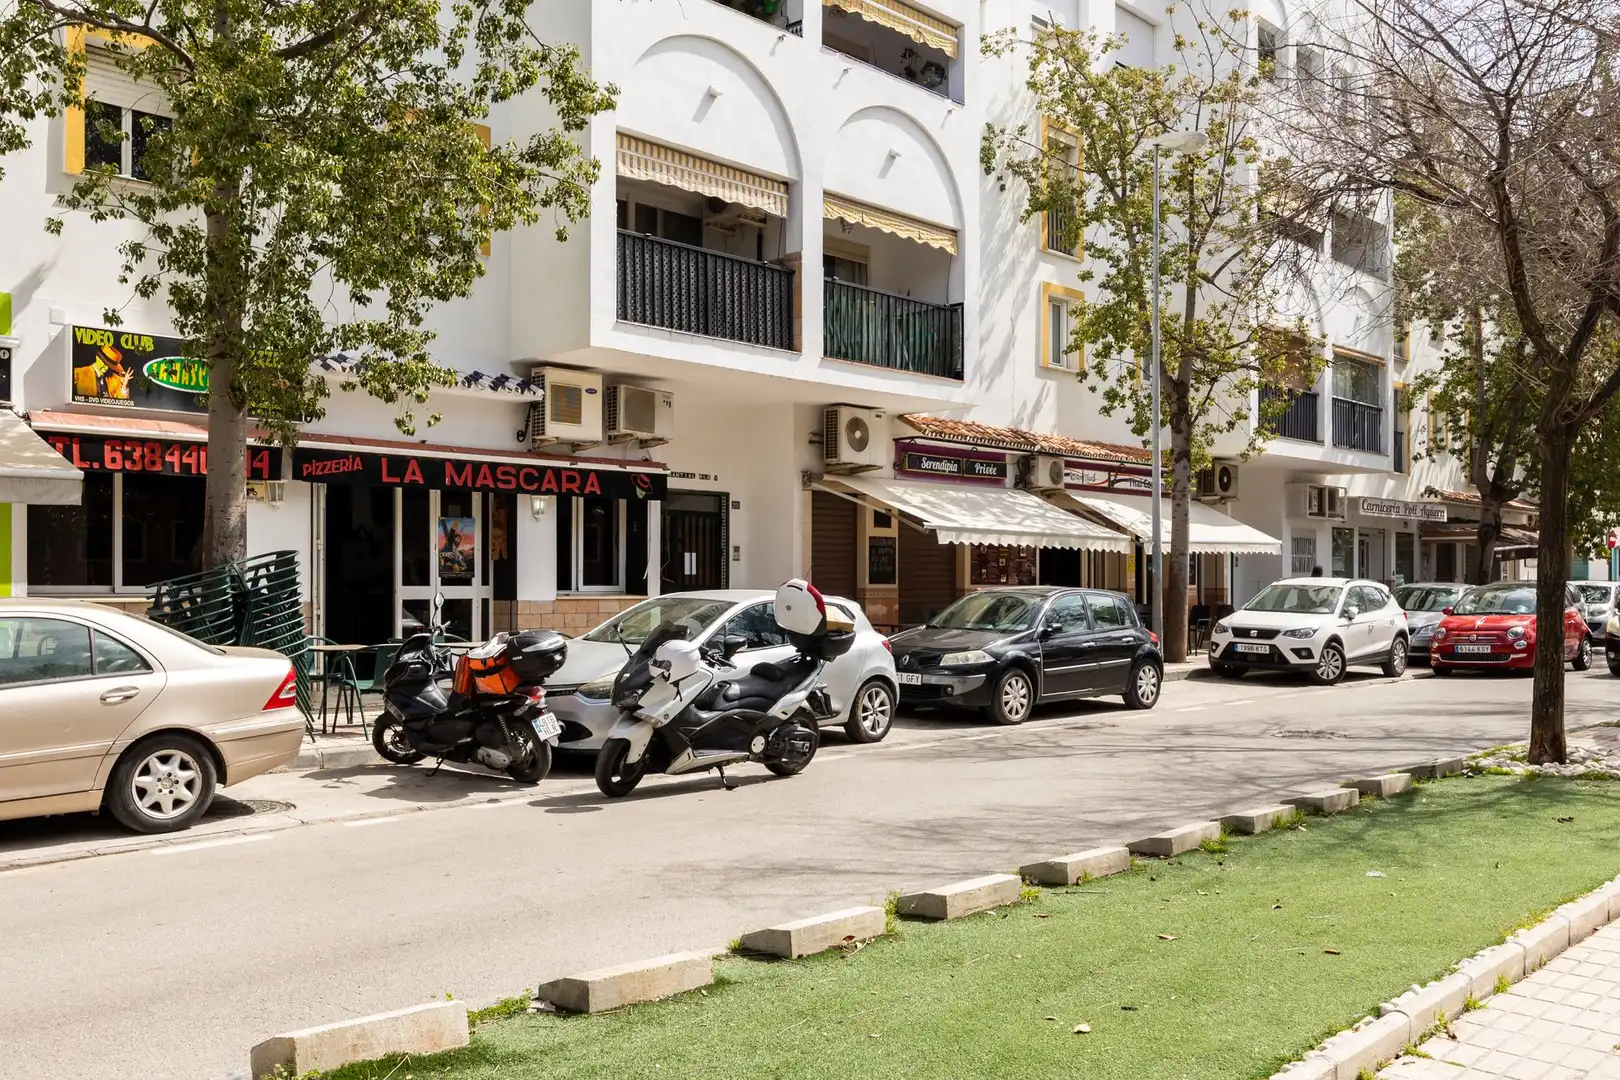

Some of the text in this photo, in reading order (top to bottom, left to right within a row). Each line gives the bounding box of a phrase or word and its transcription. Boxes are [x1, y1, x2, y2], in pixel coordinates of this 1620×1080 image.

[74, 327, 155, 352] VIDEO CLUB
[74, 395, 86, 403] VHS
[100, 398, 135, 407] VIDEOJUEGOS
[921, 456, 998, 475] Serendipia Privée
[381, 457, 425, 485] LA
[445, 461, 602, 496] MASCARA
[1362, 498, 1400, 515] Carnicería
[906, 674, 920, 684] GFY
